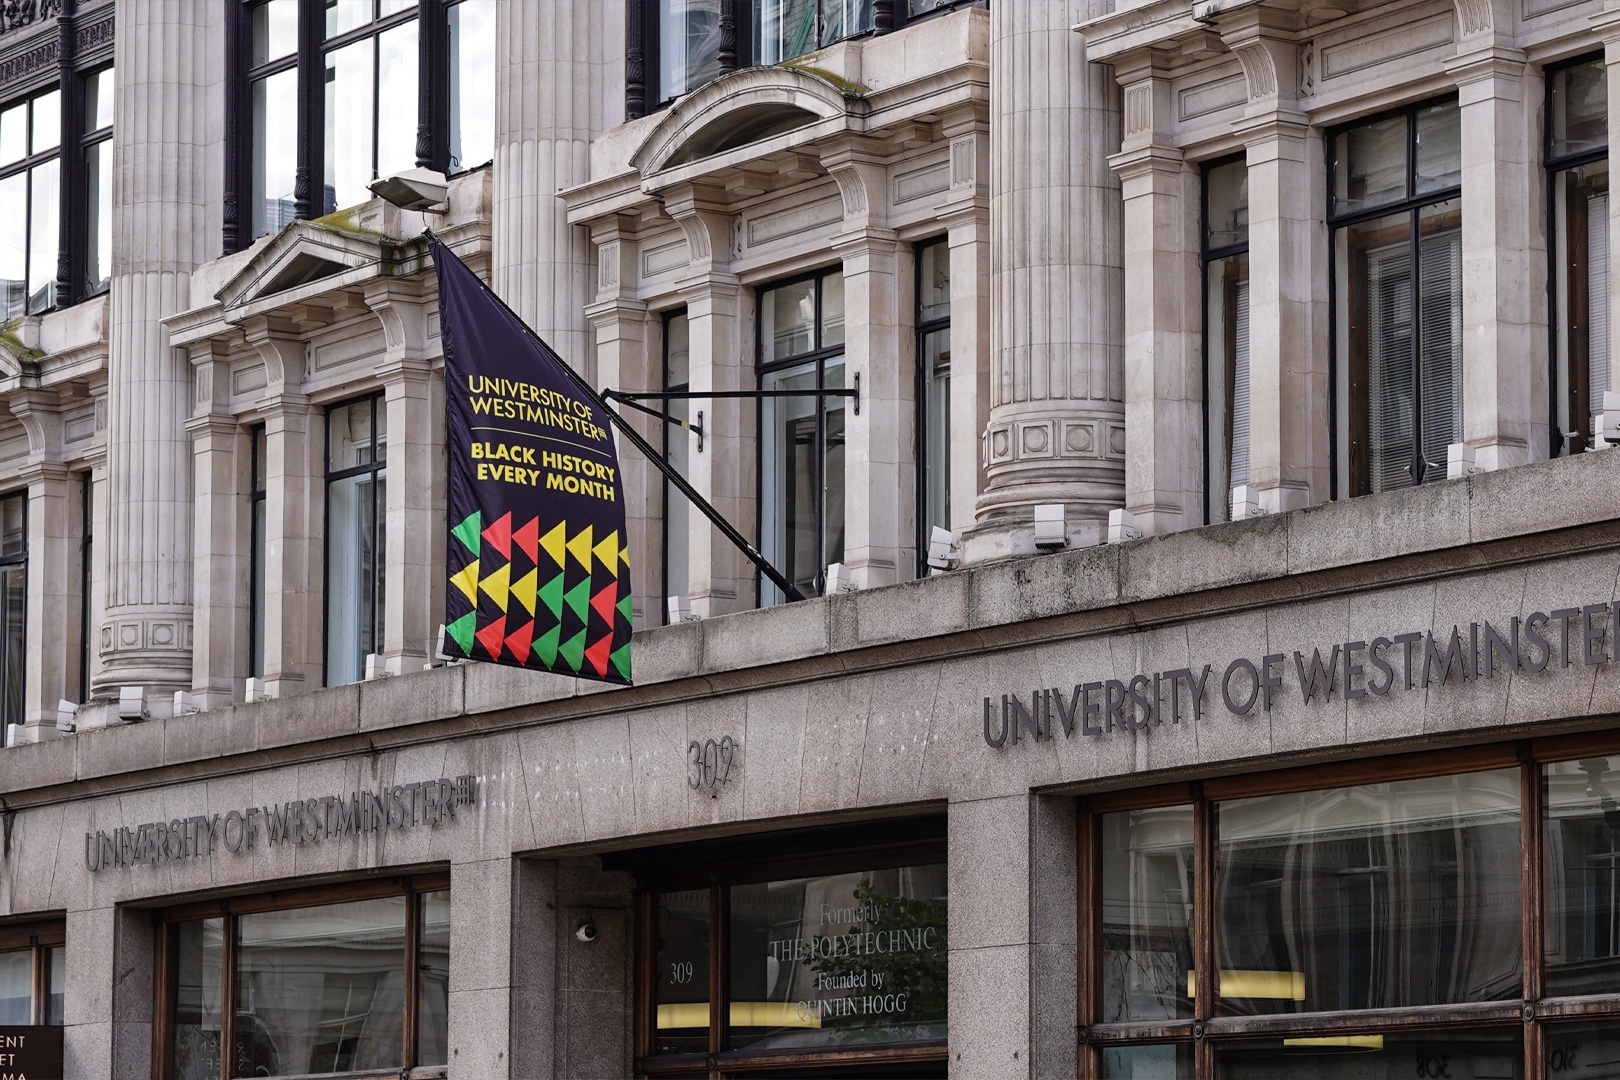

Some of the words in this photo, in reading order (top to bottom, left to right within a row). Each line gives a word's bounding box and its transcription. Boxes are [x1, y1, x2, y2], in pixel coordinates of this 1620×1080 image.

[468, 374, 572, 413] UNIVERSITY
[573, 400, 593, 421] OF
[469, 396, 601, 442] WESTMINSTER
[471, 442, 537, 465] BLACK
[542, 450, 615, 483] HISTORY
[477, 463, 540, 487] EVERY
[546, 472, 615, 502] MONTH
[984, 664, 1212, 748] UNIVERSITY
[1221, 653, 1285, 716] OF
[688, 735, 734, 790] 309
[85, 813, 219, 872] UNIVERSITY
[222, 807, 259, 853] OF
[263, 778, 454, 847] WESTMINSTER
[820, 899, 882, 926] Formerly
[770, 938, 804, 962] THE
[811, 926, 936, 960] POLYTECHNIC
[670, 961, 693, 985] 309
[818, 969, 867, 990] Founded
[870, 969, 885, 990] by
[797, 996, 858, 1022] QUINTIN
[863, 993, 907, 1015] HOGG
